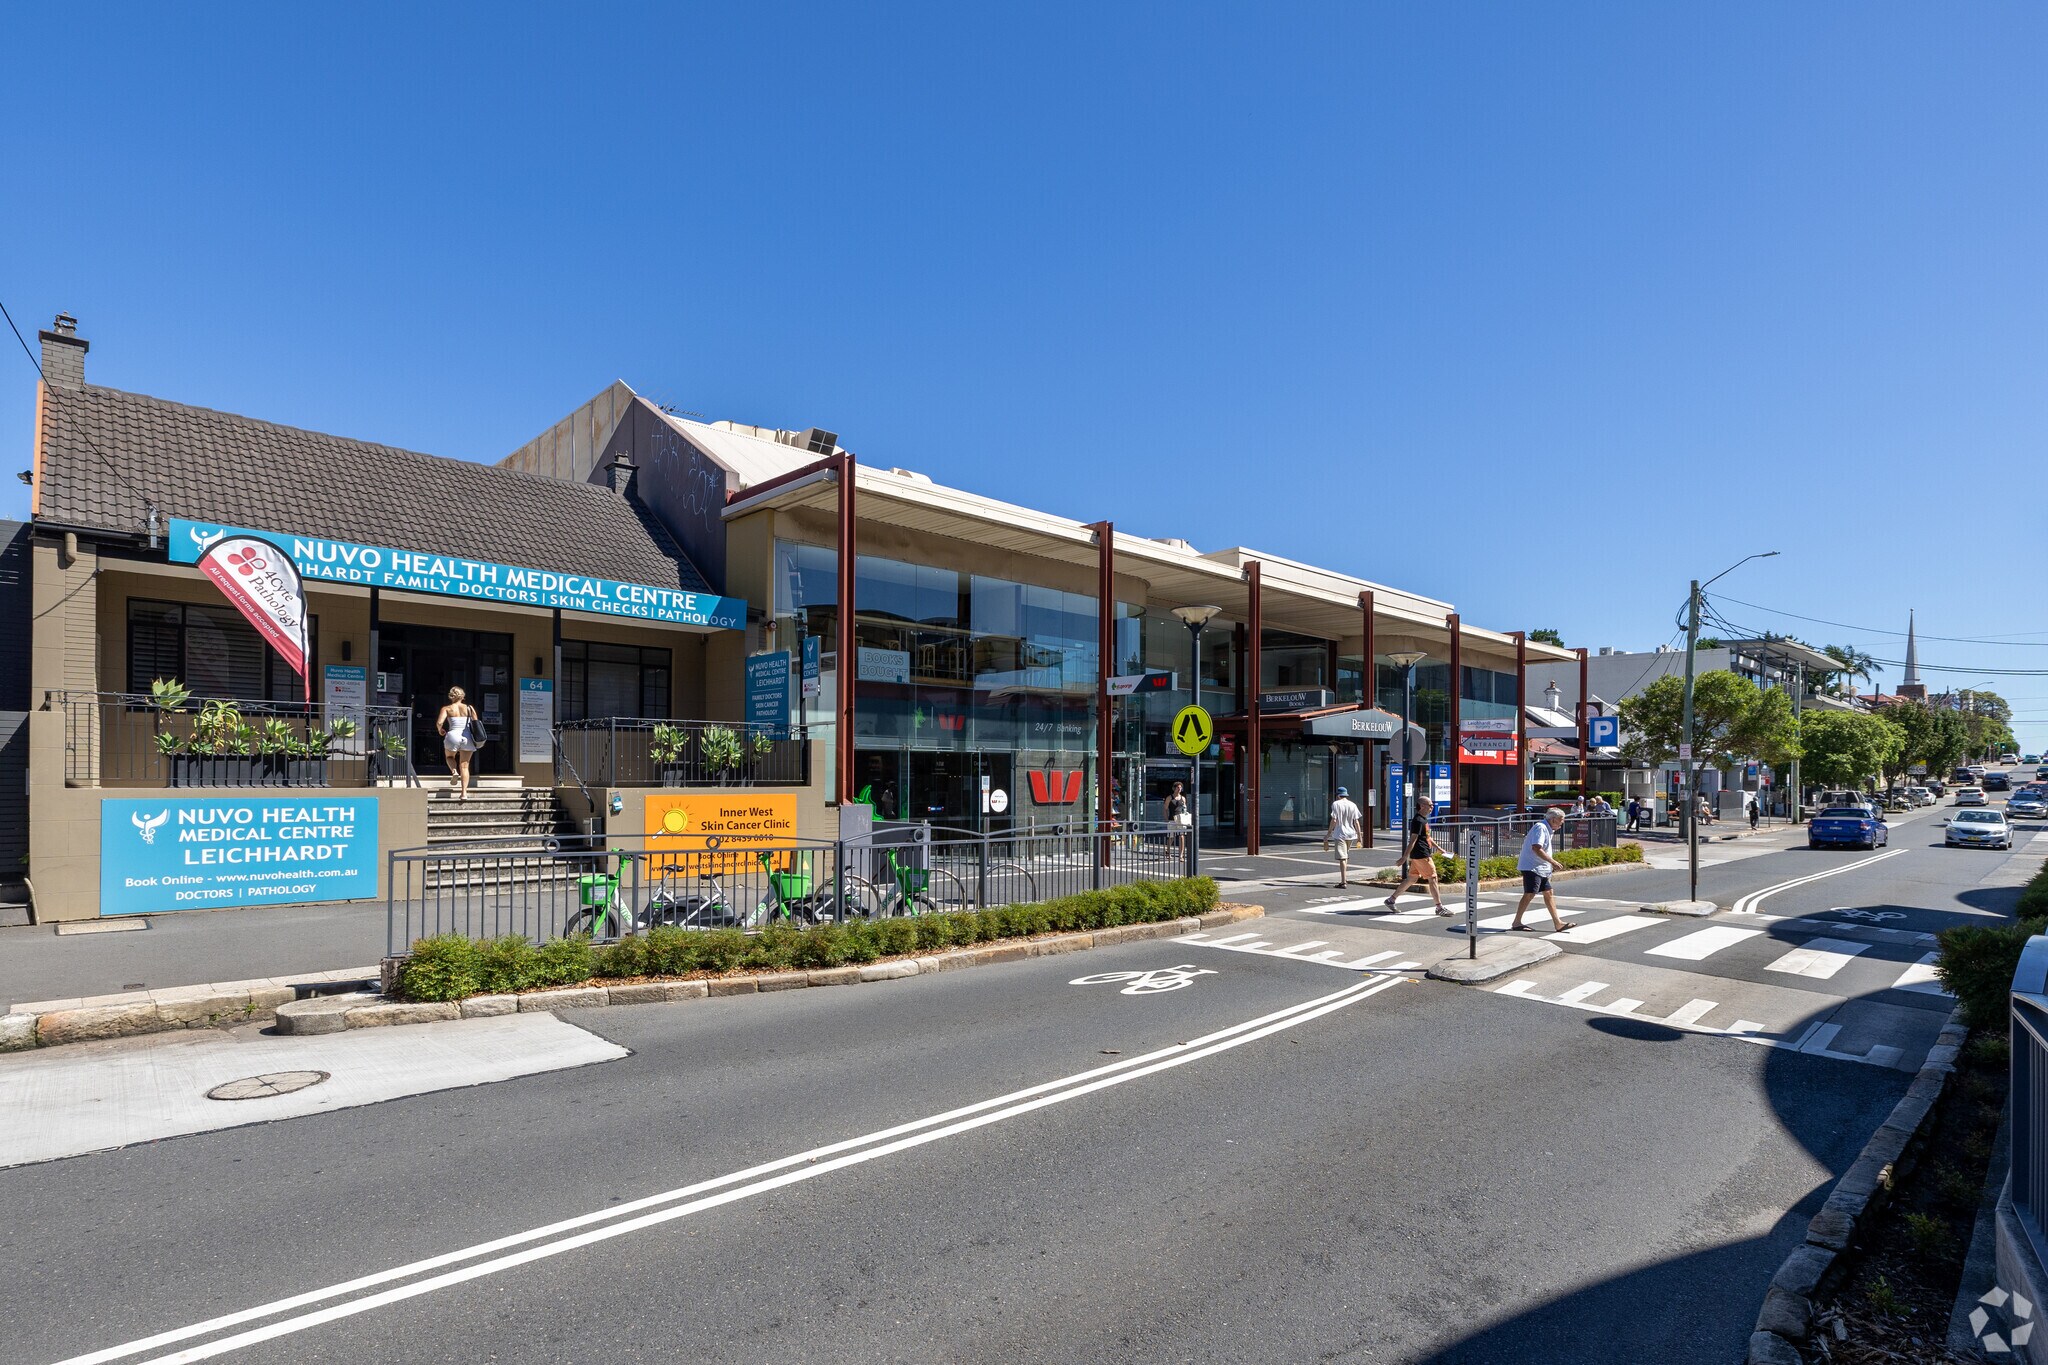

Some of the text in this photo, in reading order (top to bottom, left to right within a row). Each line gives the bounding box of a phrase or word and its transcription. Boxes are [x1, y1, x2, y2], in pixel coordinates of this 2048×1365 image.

[294, 538, 697, 610] NUVO HEALTH MEDICAL CENTRE
[265, 571, 294, 602] 4Cyte
[210, 567, 280, 638] All request forms accepted
[248, 576, 298, 627] Pathology
[383, 573, 451, 592] FAMILY
[459, 583, 538, 602] DOCTORS
[550, 595, 585, 609] SKIN
[592, 600, 649, 616] CHECKS
[658, 609, 736, 627] PATHOLOGY
[755, 659, 786, 670] NUVO HEALTH
[864, 651, 904, 666] BOOKS
[860, 664, 908, 679] BOUGHT
[529, 681, 543, 690] 64
[756, 676, 785, 686] LEICHHARDT
[765, 692, 782, 700] DOCTORS
[1035, 721, 1082, 735] 24/7 Banking
[1594, 720, 1613, 743] P
[178, 807, 355, 825] NUVO HEALTH
[720, 807, 773, 817] Inner West
[701, 819, 790, 831] Skin Cancer Clinic
[178, 825, 354, 843] MEDICAL CENTRE
[184, 844, 348, 865] LEICHHARDT
[125, 876, 158, 888] Book
[162, 875, 203, 886] Online
[216, 868, 358, 883] www.nuvohealth.com.au
[175, 888, 233, 901] DOCTORS
[248, 884, 317, 897] PATHOLOGY
